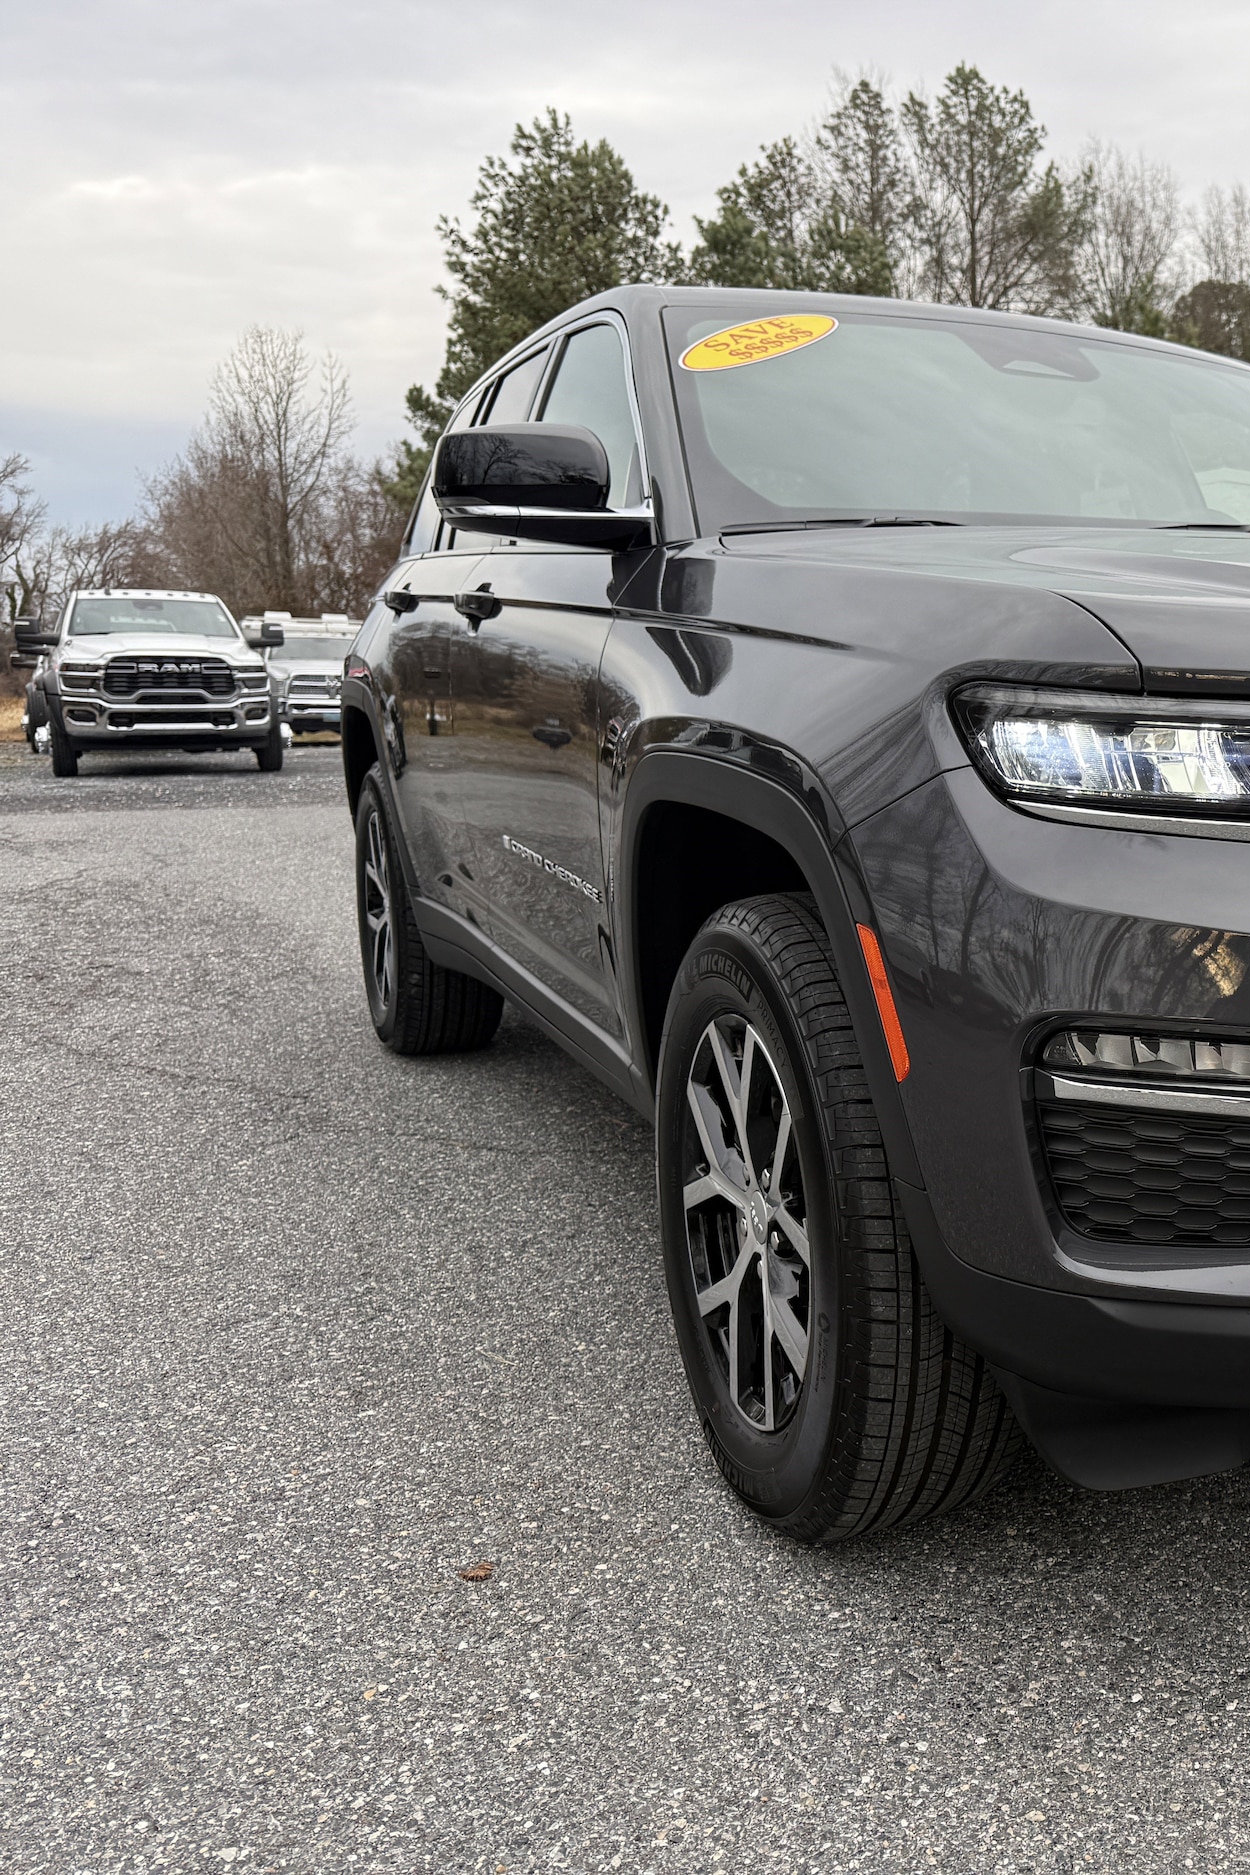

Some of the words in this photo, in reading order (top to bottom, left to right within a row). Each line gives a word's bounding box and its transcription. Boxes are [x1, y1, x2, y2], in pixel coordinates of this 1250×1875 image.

[703, 318, 795, 352] SAVE
[138, 662, 200, 673] RAM
[698, 953, 752, 996] MICHELIN
[756, 1000, 791, 1069] PRIMACY
